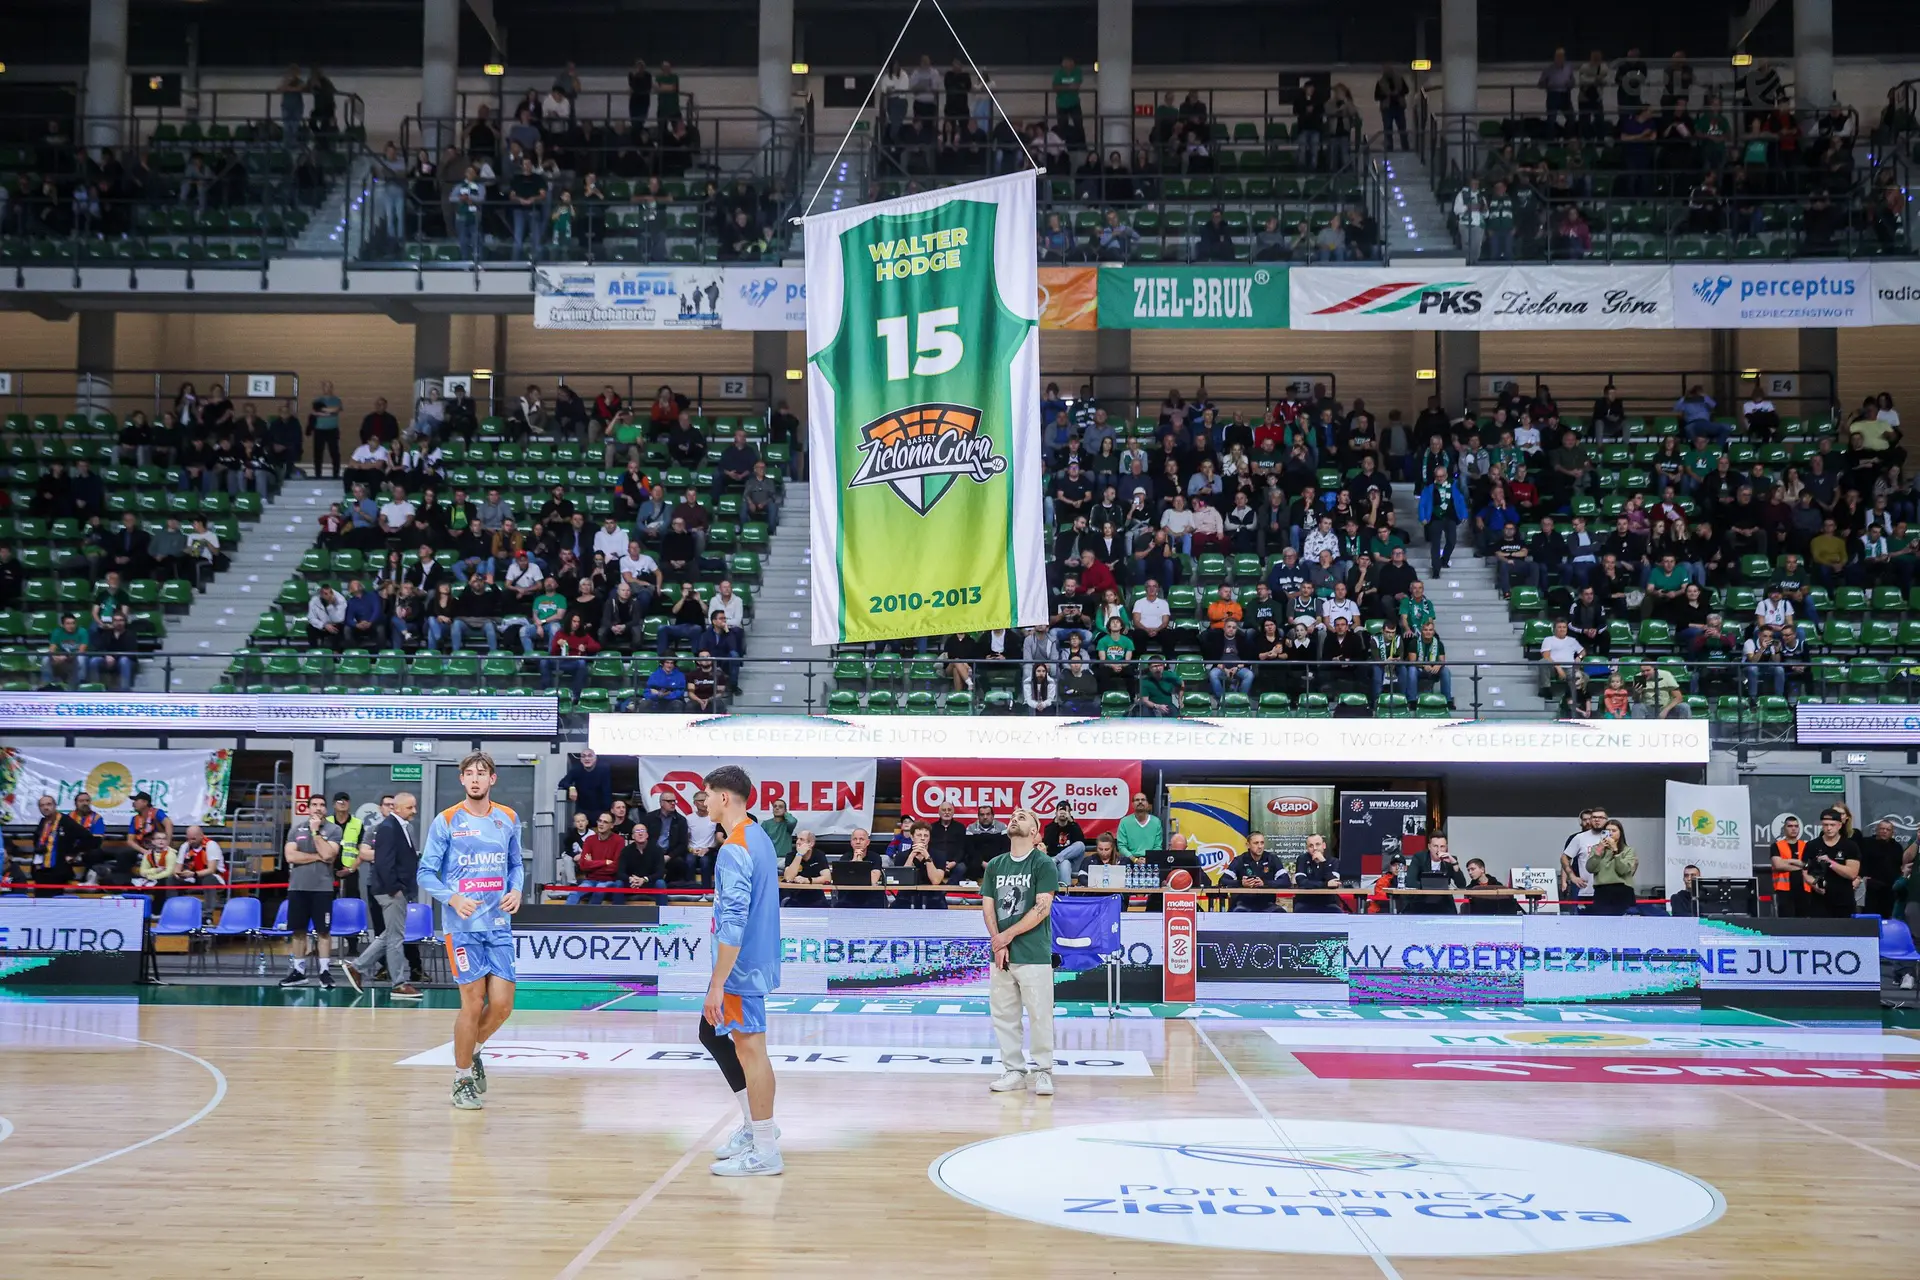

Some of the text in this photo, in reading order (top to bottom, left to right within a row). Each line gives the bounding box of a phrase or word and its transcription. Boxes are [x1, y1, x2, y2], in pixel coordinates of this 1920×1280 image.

[868, 228, 968, 262] WALTER
[876, 250, 961, 281] HODGE
[608, 280, 677, 296] ARPOL
[1741, 276, 1855, 303] perceptus
[1879, 286, 1920, 301] radio
[1418, 289, 1658, 316] PKS Zielona Góra
[876, 306, 964, 381] 15
[725, 382, 743, 393] E2
[907, 435, 937, 446] BASKET
[869, 586, 982, 614] 2010-2013
[354, 707, 499, 721] CYBERBEZPIECZNE
[502, 708, 550, 721] JUTRO
[1806, 716, 1900, 730] TWORZYMY
[709, 728, 884, 744] CYBERBEZPIECZNE
[889, 730, 947, 744] JUTRO
[1077, 731, 1254, 746] CYBERBEZPIECZNE
[1261, 732, 1319, 746] JUTRO
[1452, 733, 1632, 748] CYBERBEZPIECZNE
[1638, 734, 1699, 748] JUTRO
[923, 784, 1118, 807] ORLEN Basket
[1272, 801, 1313, 813] Agapol
[1369, 799, 1419, 810] www.kssse.pl
[458, 853, 506, 866] GLIWICE
[1198, 850, 1223, 867] OTTO
[18, 928, 125, 951] JUTRO
[513, 935, 701, 961] TWORZYMY
[1746, 950, 1861, 975] JUTRO
[647, 1050, 850, 1064] Bnk
[1120, 1184, 1537, 1203] Port Lotniczy
[1063, 1198, 1632, 1223] Zielona Góra
